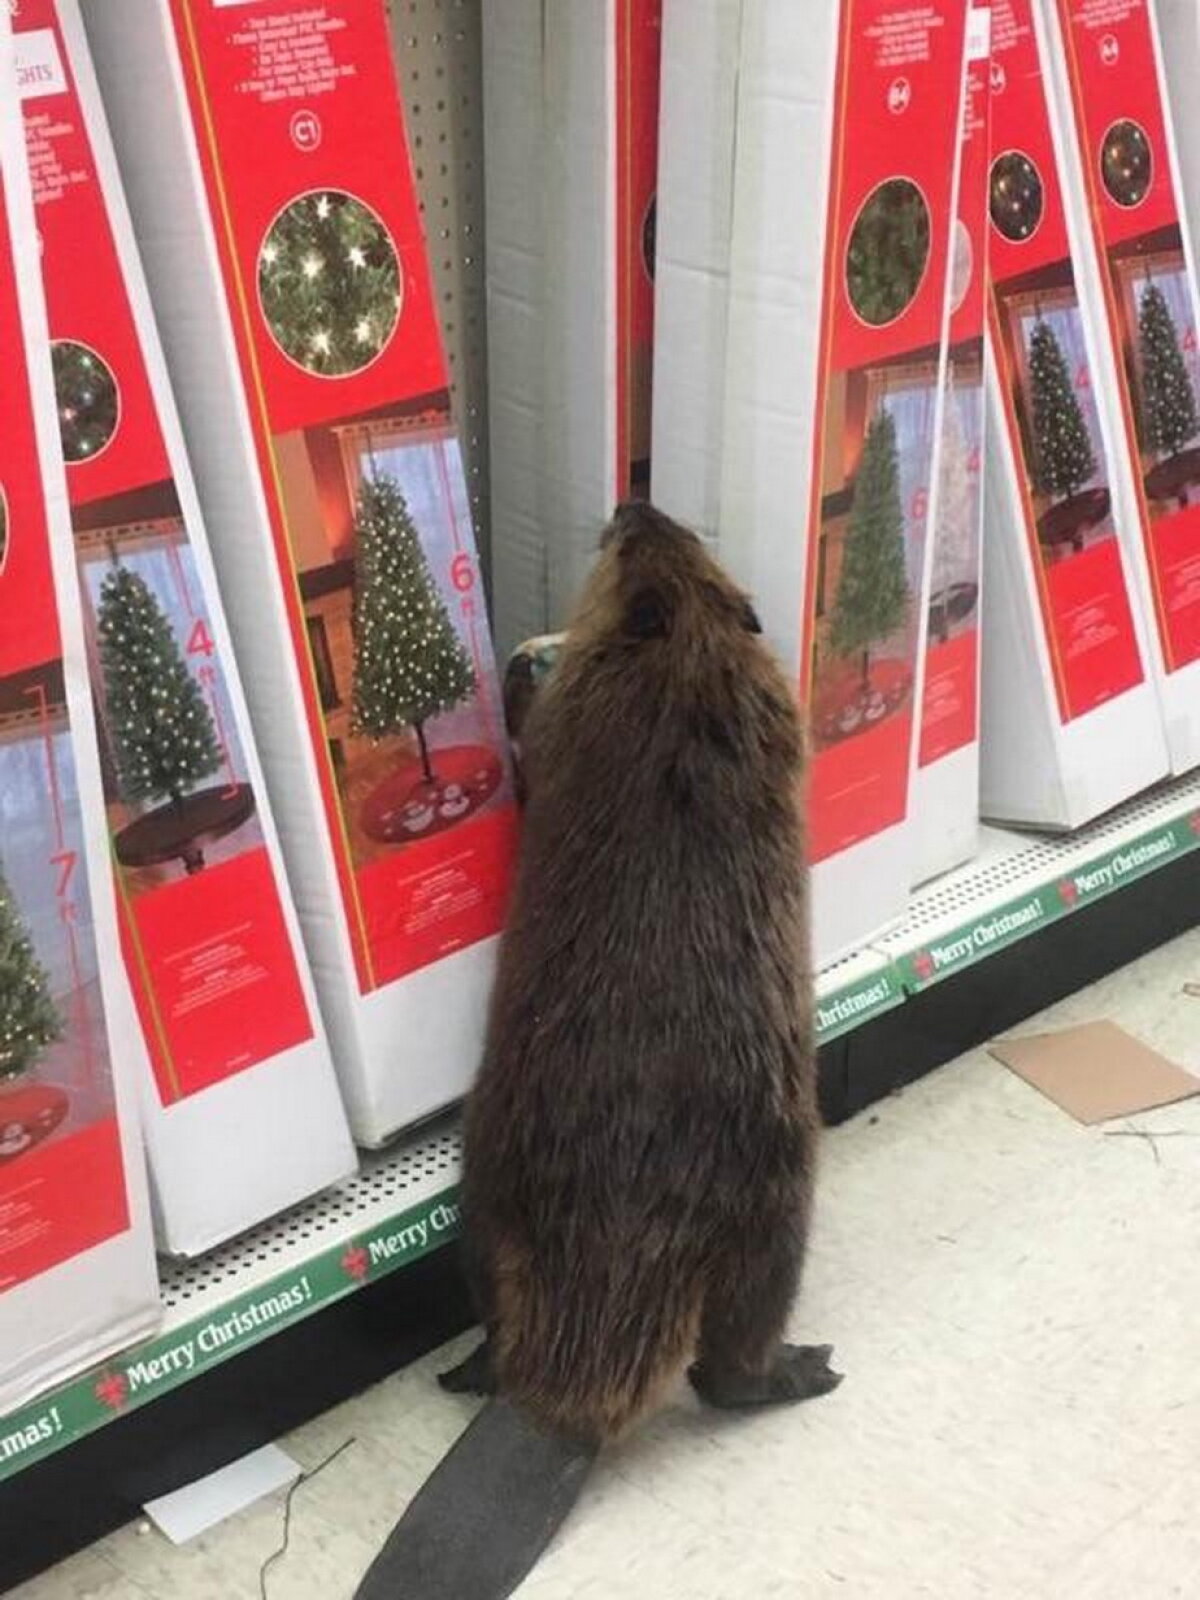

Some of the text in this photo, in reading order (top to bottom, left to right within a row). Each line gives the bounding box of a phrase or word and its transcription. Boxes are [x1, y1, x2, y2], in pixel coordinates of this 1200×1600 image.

[451, 552, 474, 592] 6
[187, 619, 214, 656] 4
[49, 851, 76, 897] 7
[1074, 831, 1177, 895] Merry Christmas!
[930, 897, 1044, 970] Merry Christmas!
[815, 978, 891, 1031] hristmas!
[368, 1219, 428, 1265] Merry
[127, 1275, 314, 1391] Merry Christmas!
